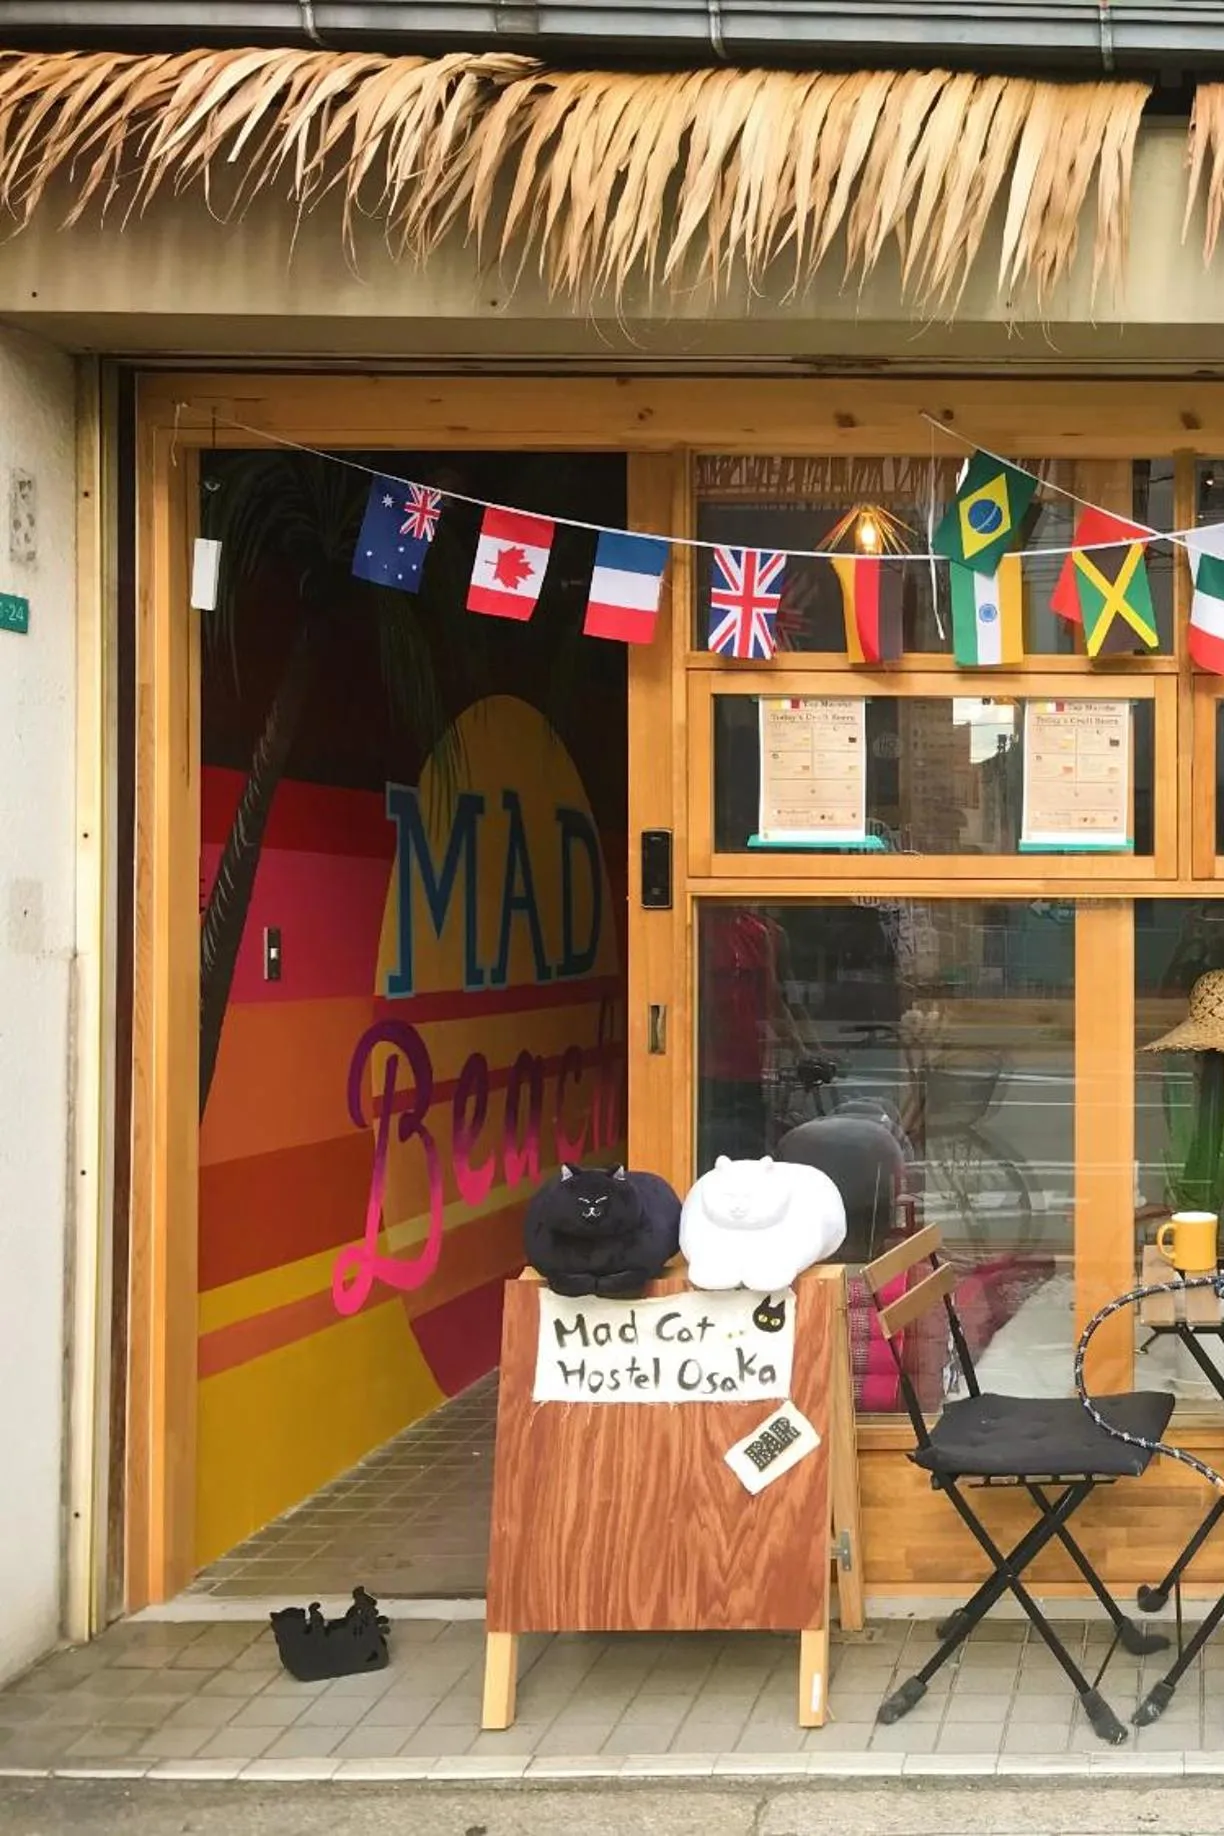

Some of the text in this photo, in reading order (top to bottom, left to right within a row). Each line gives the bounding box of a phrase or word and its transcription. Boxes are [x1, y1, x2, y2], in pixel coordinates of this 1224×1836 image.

[386, 781, 600, 999] MAD
[332, 1001, 624, 1315] Beach
[553, 1309, 715, 1349] Mad Cat
[556, 1346, 777, 1394] Hostel Osaka
[743, 1416, 802, 1473] BAR
